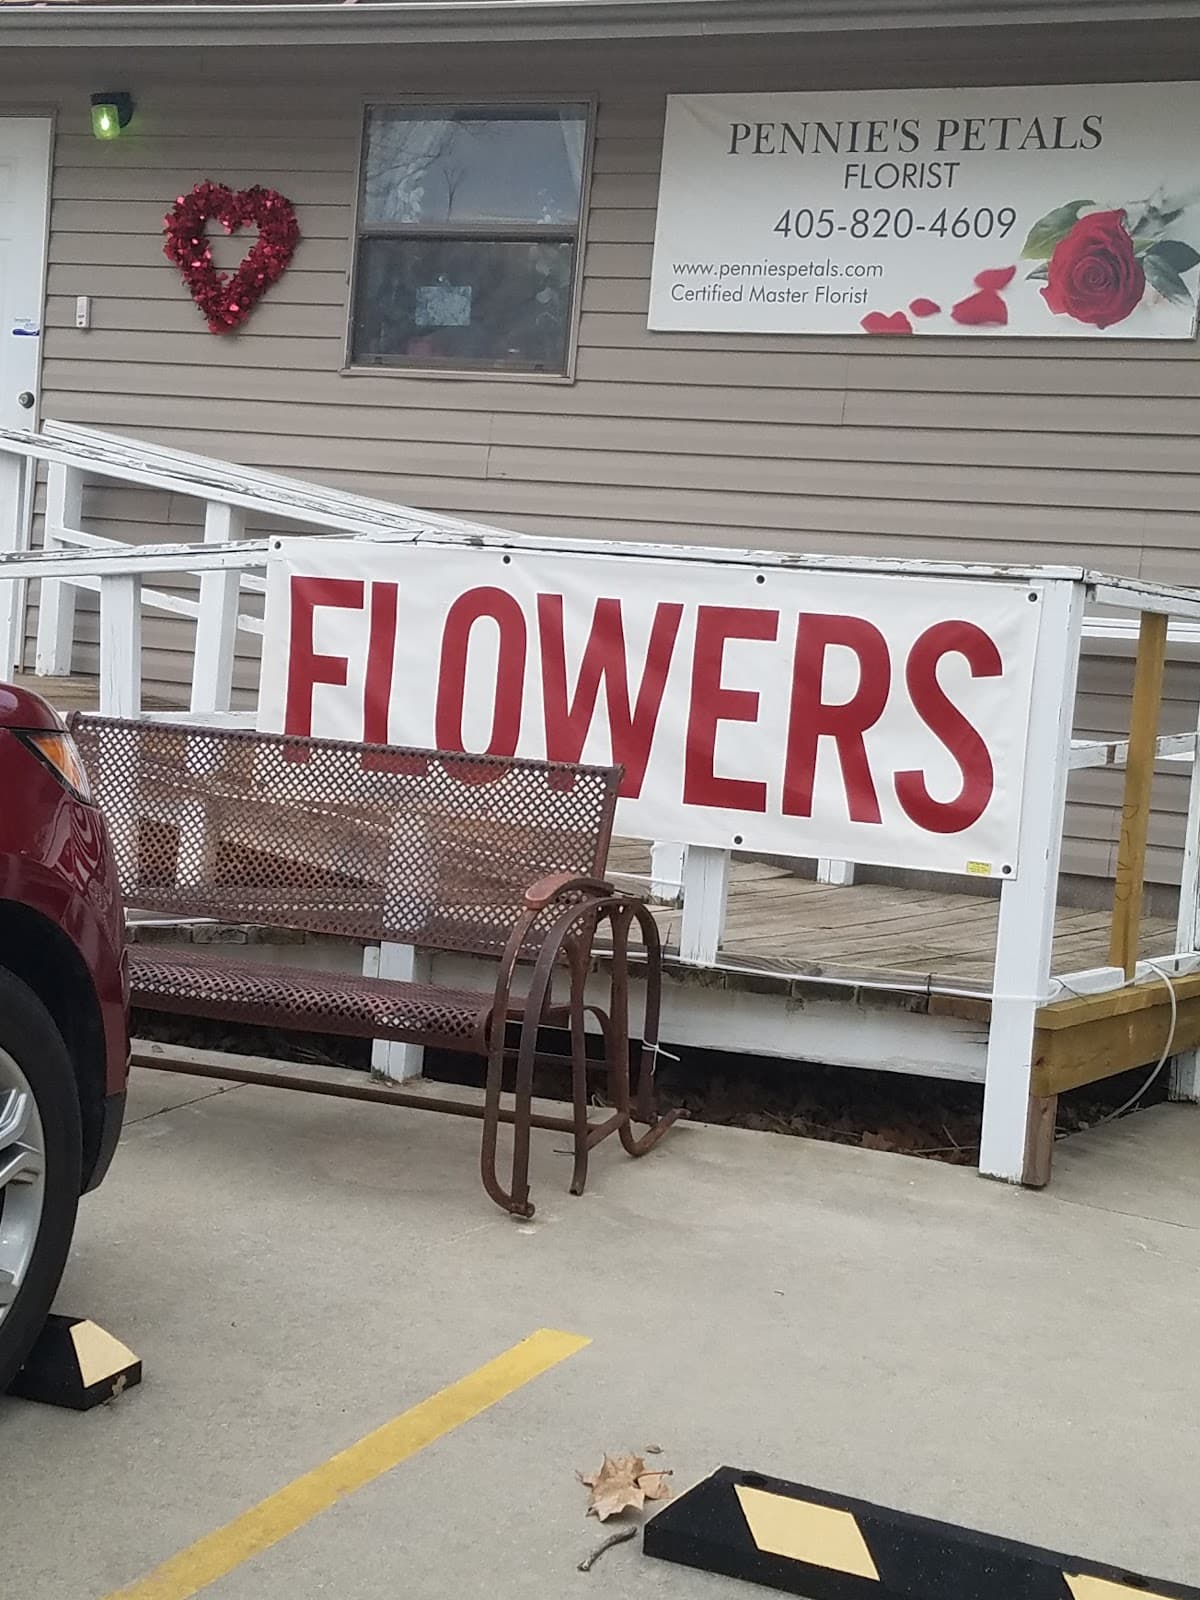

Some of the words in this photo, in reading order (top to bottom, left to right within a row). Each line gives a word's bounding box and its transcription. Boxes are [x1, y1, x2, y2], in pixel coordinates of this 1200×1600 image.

[727, 118, 920, 155] PENNIE'S
[933, 114, 1104, 153] PETALS
[844, 162, 961, 190] FLORIST
[773, 207, 1017, 239] 405-820-4609
[672, 258, 883, 280] www.penniespetals.com
[671, 284, 742, 302] Certified
[748, 286, 810, 304] Master
[815, 287, 868, 304] Florist
[282, 575, 1004, 834] FLOWERS
